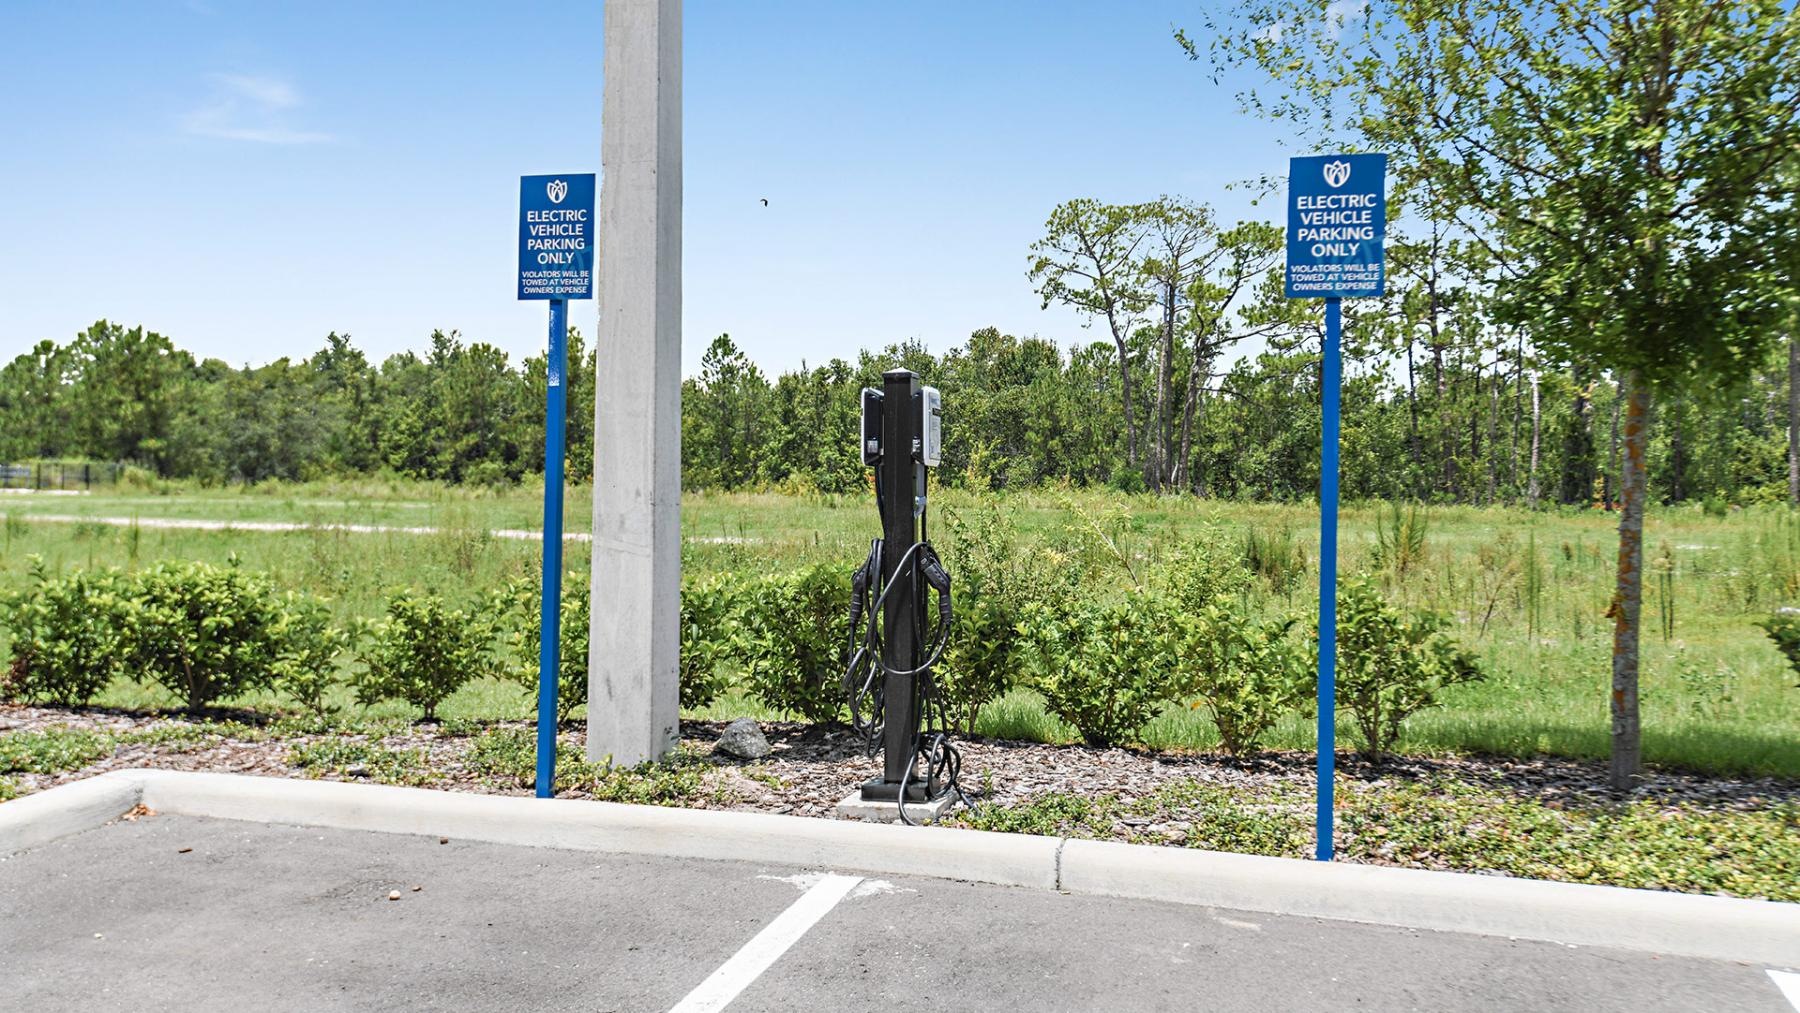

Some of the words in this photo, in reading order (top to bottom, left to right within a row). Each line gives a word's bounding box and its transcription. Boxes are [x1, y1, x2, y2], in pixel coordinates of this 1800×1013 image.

[1297, 193, 1377, 209] ELECTRIC
[527, 209, 587, 221] ELECTRIC
[1300, 210, 1372, 225] VEHICLE
[529, 224, 584, 236] VEHICLE
[1297, 226, 1374, 241] PARKING
[527, 238, 585, 250] PARKING
[1311, 243, 1360, 257] ONLY
[537, 252, 574, 264] ONLY
[1291, 264, 1342, 273] VIOLATORS
[1344, 264, 1365, 272] WILL
[1368, 263, 1380, 271] BE
[1291, 273, 1325, 282] TOWED
[1326, 273, 1339, 281] AT
[1341, 272, 1379, 281] VEHICLE
[555, 286, 588, 294] EXPENSE
[1292, 282, 1333, 291] OWNERS
[1335, 281, 1377, 290] EXPENSE
